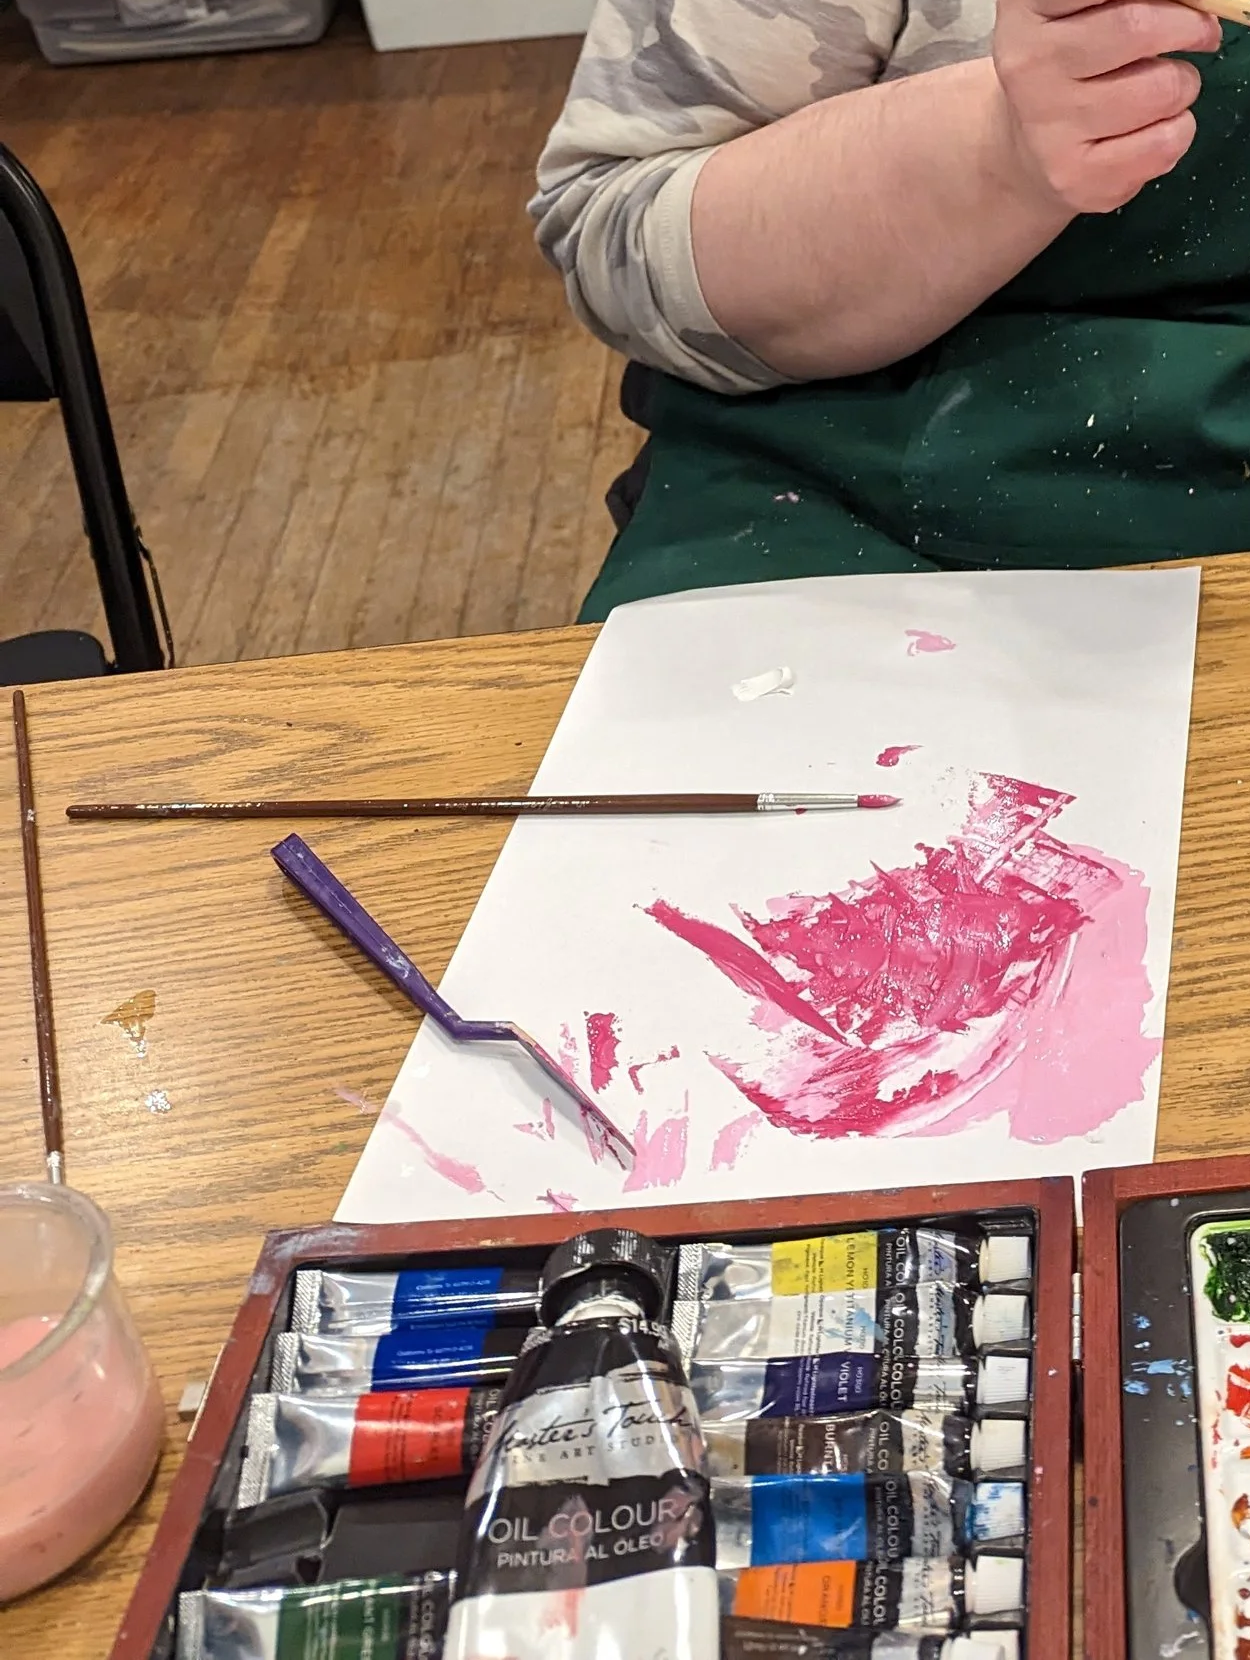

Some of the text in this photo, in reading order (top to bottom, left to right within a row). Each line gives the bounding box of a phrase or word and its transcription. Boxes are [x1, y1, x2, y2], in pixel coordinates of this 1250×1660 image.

[845, 1237, 855, 1278] LEMON
[618, 1317, 670, 1340] $14.99
[844, 1292, 855, 1346] TITANIUM
[836, 1361, 851, 1403] VIOLET
[560, 1445, 597, 1460] ART
[823, 1423, 836, 1466] BURNT
[878, 1421, 890, 1446] OIL
[885, 1480, 898, 1503] OIL
[488, 1498, 677, 1545] OIL COLOUR
[497, 1533, 664, 1568] PINTURA AL OLEO
